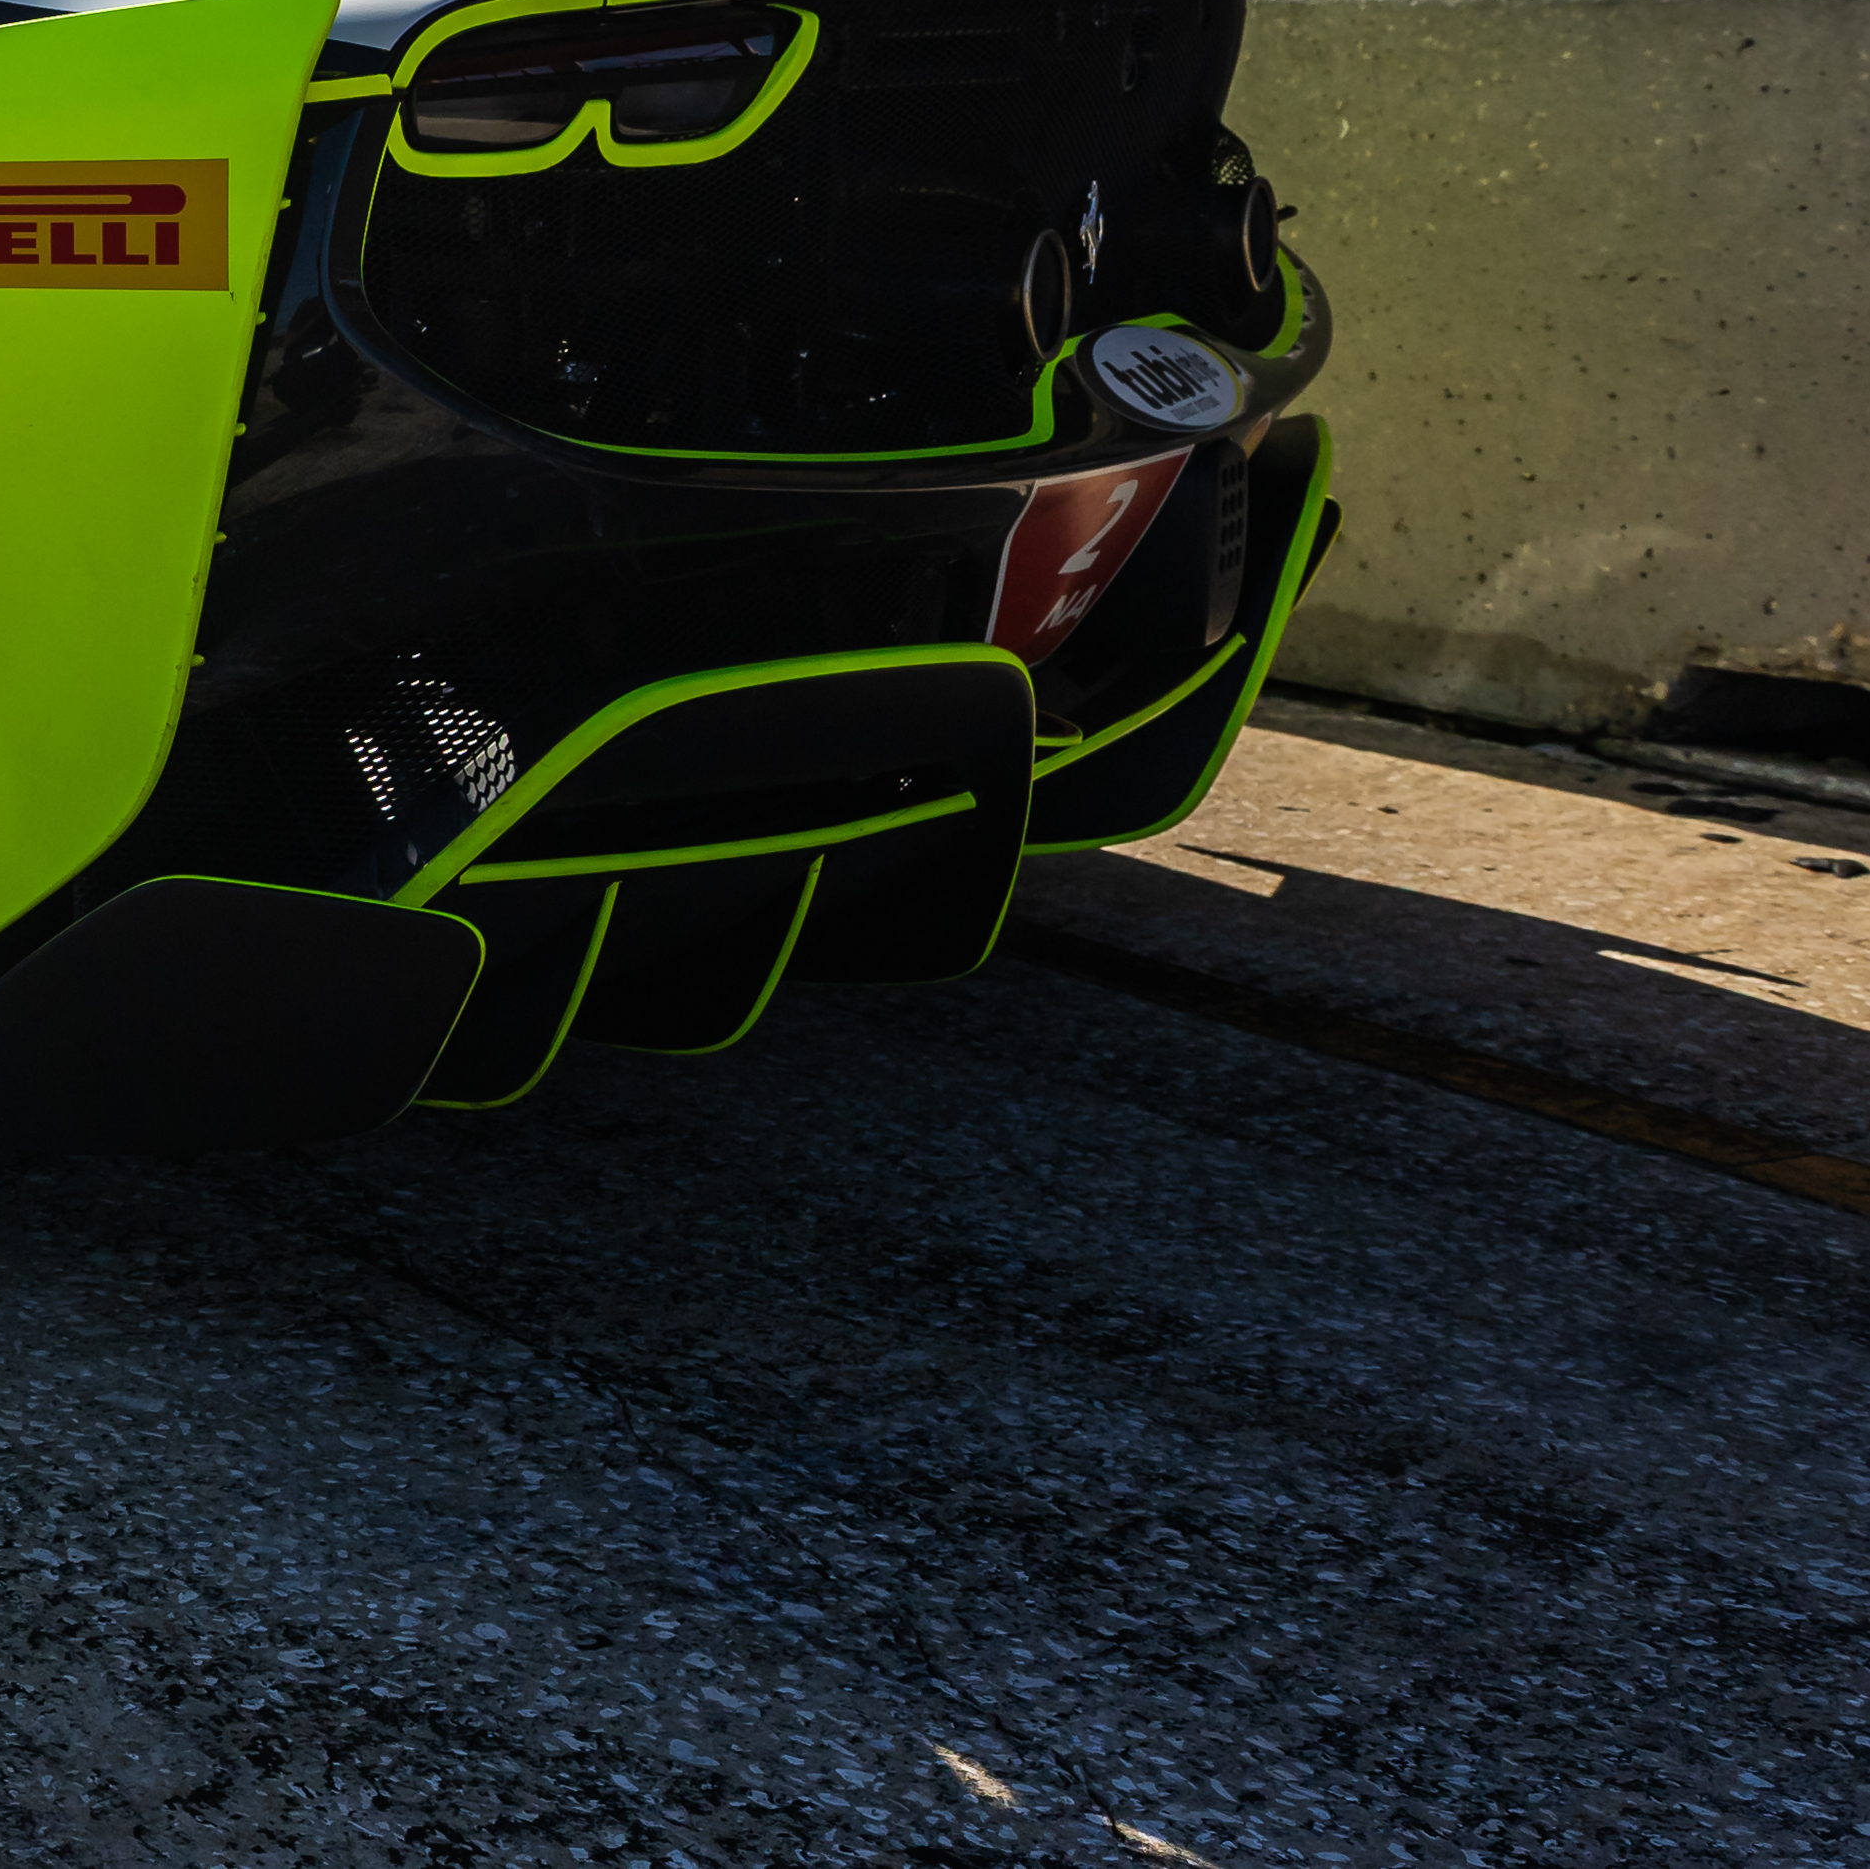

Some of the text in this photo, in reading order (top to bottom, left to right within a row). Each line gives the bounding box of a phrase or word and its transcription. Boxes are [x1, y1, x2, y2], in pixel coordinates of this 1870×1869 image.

[1101, 345, 1206, 410] tubi
[1058, 479, 1139, 575] 2
[1033, 584, 1098, 634] NA
